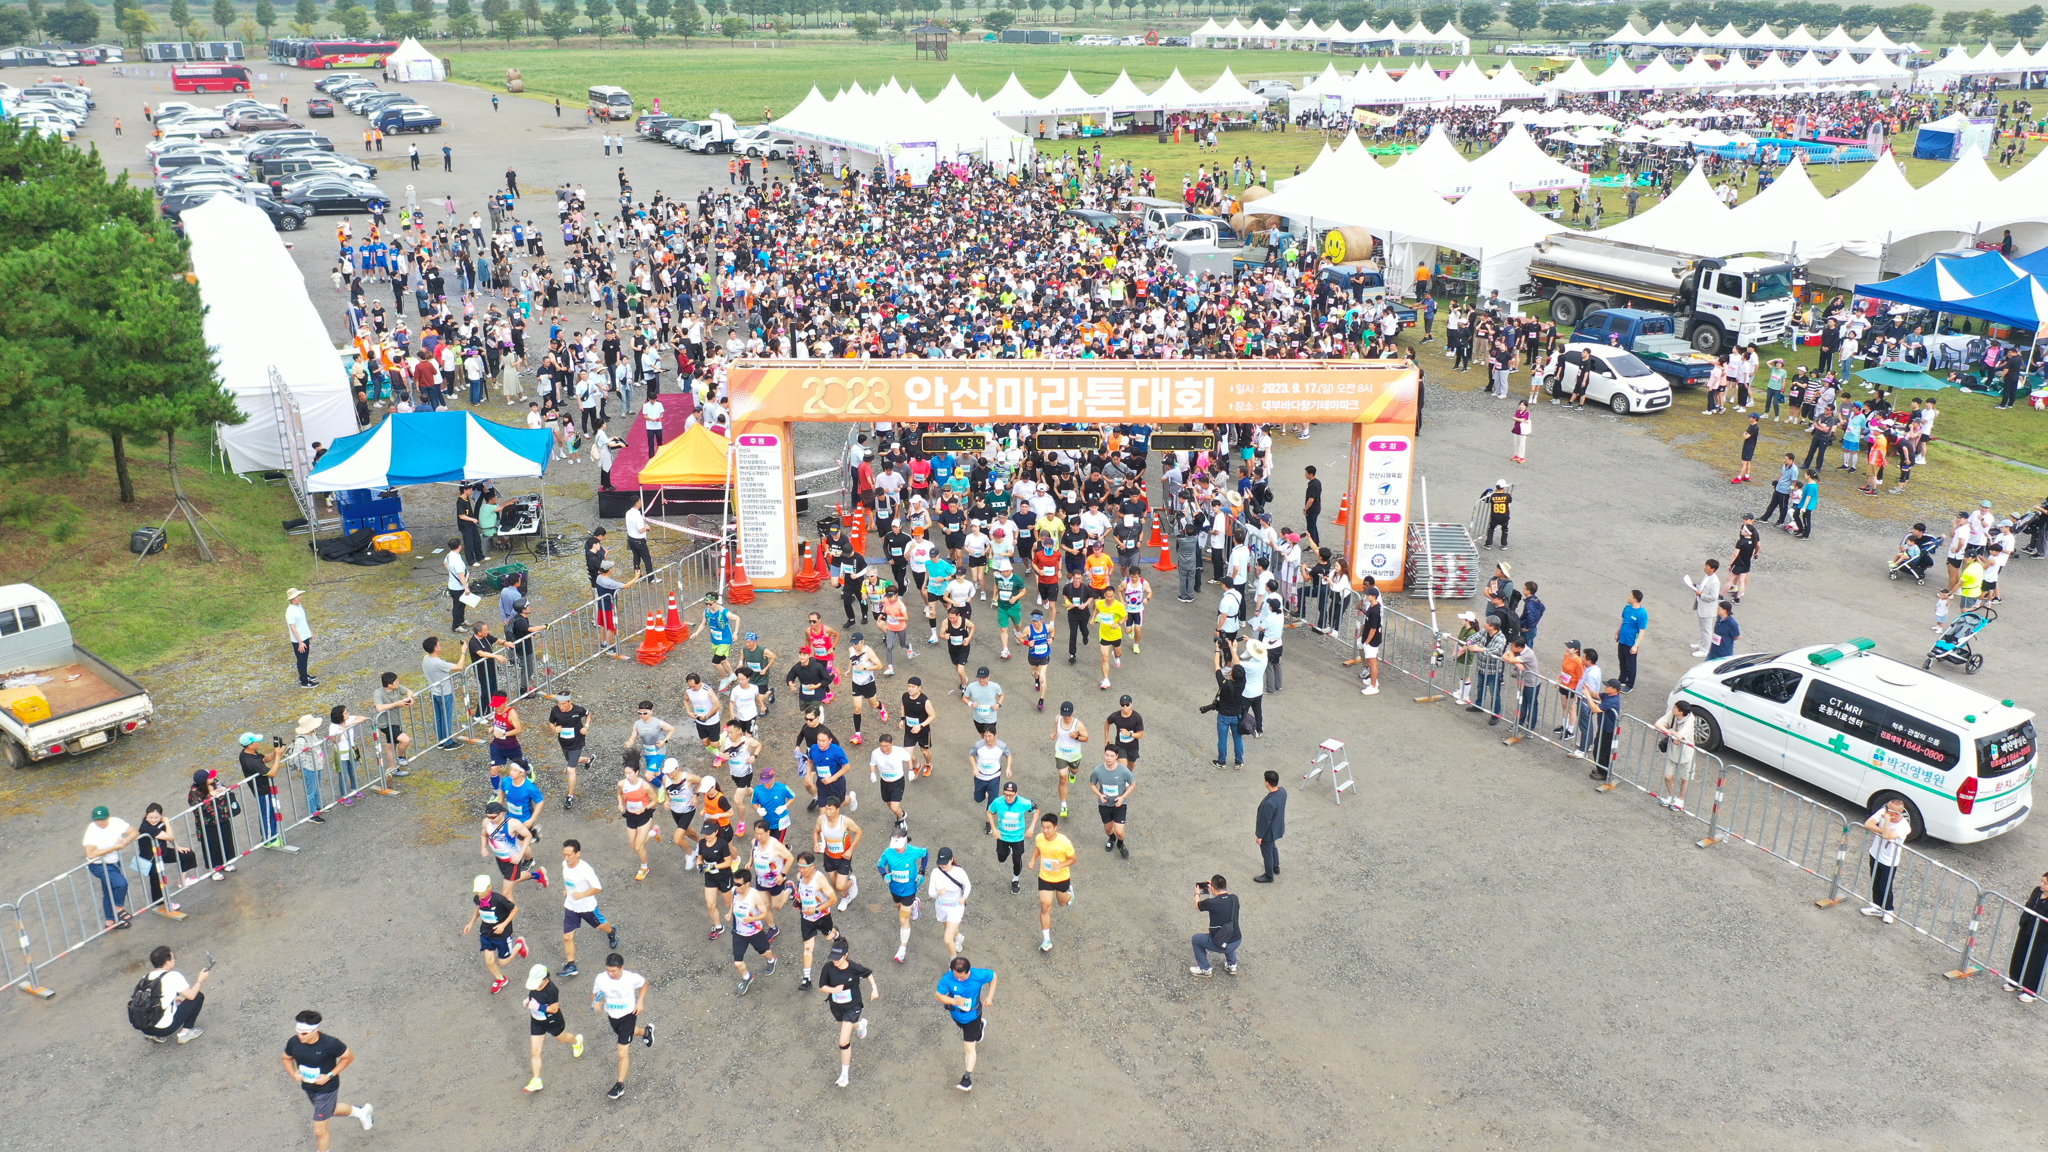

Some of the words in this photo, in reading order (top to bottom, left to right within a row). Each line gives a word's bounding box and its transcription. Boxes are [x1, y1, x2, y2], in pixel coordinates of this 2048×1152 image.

[1235, 383, 1254, 394] 일시
[1336, 383, 1355, 394] 오전
[1357, 383, 1373, 394] 8시
[802, 376, 892, 414] 2023
[904, 376, 1215, 417] 안산마라톤대회
[1234, 401, 1253, 412] 장소
[1261, 400, 1359, 411] 대부바다향기테마파크
[749, 437, 765, 445] 후원
[1379, 442, 1397, 450] 주최
[1369, 498, 1399, 506] 경기일보
[1493, 503, 1506, 514] 89
[1373, 514, 1391, 522] 주관
[1361, 569, 1395, 577] 안산육상연맹
[1829, 697, 1862, 716] CT.MRI
[1818, 704, 1863, 729] 운동치료센터
[1880, 730, 1902, 745] 진료예약
[1902, 738, 1945, 762] 1644-0800
[1887, 756, 1946, 788] 박진영병원
